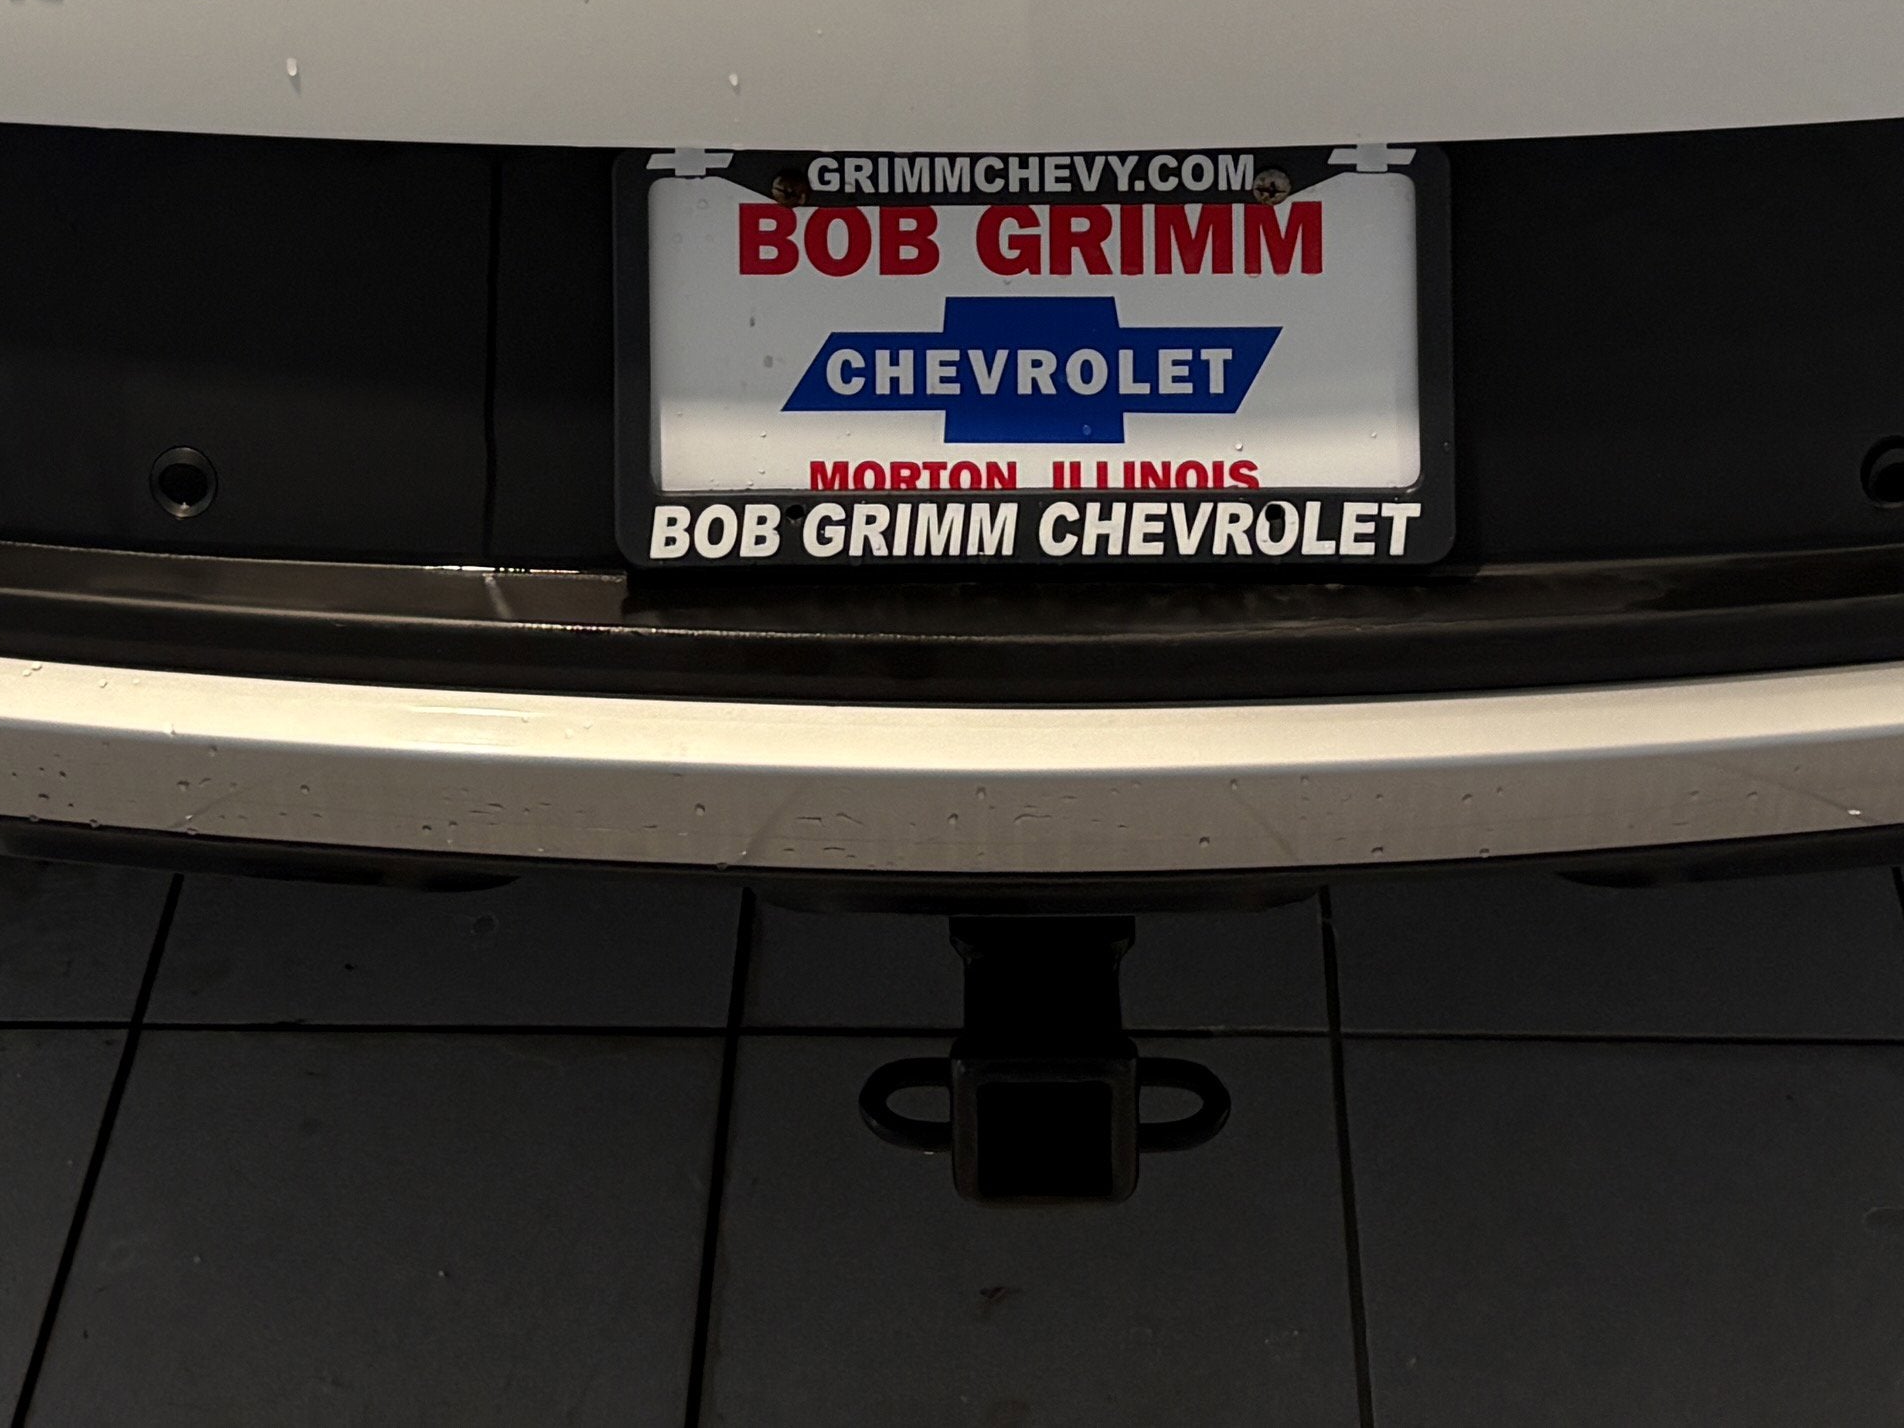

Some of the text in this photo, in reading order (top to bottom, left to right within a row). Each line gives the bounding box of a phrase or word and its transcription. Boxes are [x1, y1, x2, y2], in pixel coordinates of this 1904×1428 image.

[807, 155, 1254, 194] GRIMMCHEVY.COM
[739, 201, 1323, 277] BOB GRIMM
[826, 349, 1233, 396] CHEVROLET
[650, 500, 1421, 559] BOB GRIMM CHEVROLET
